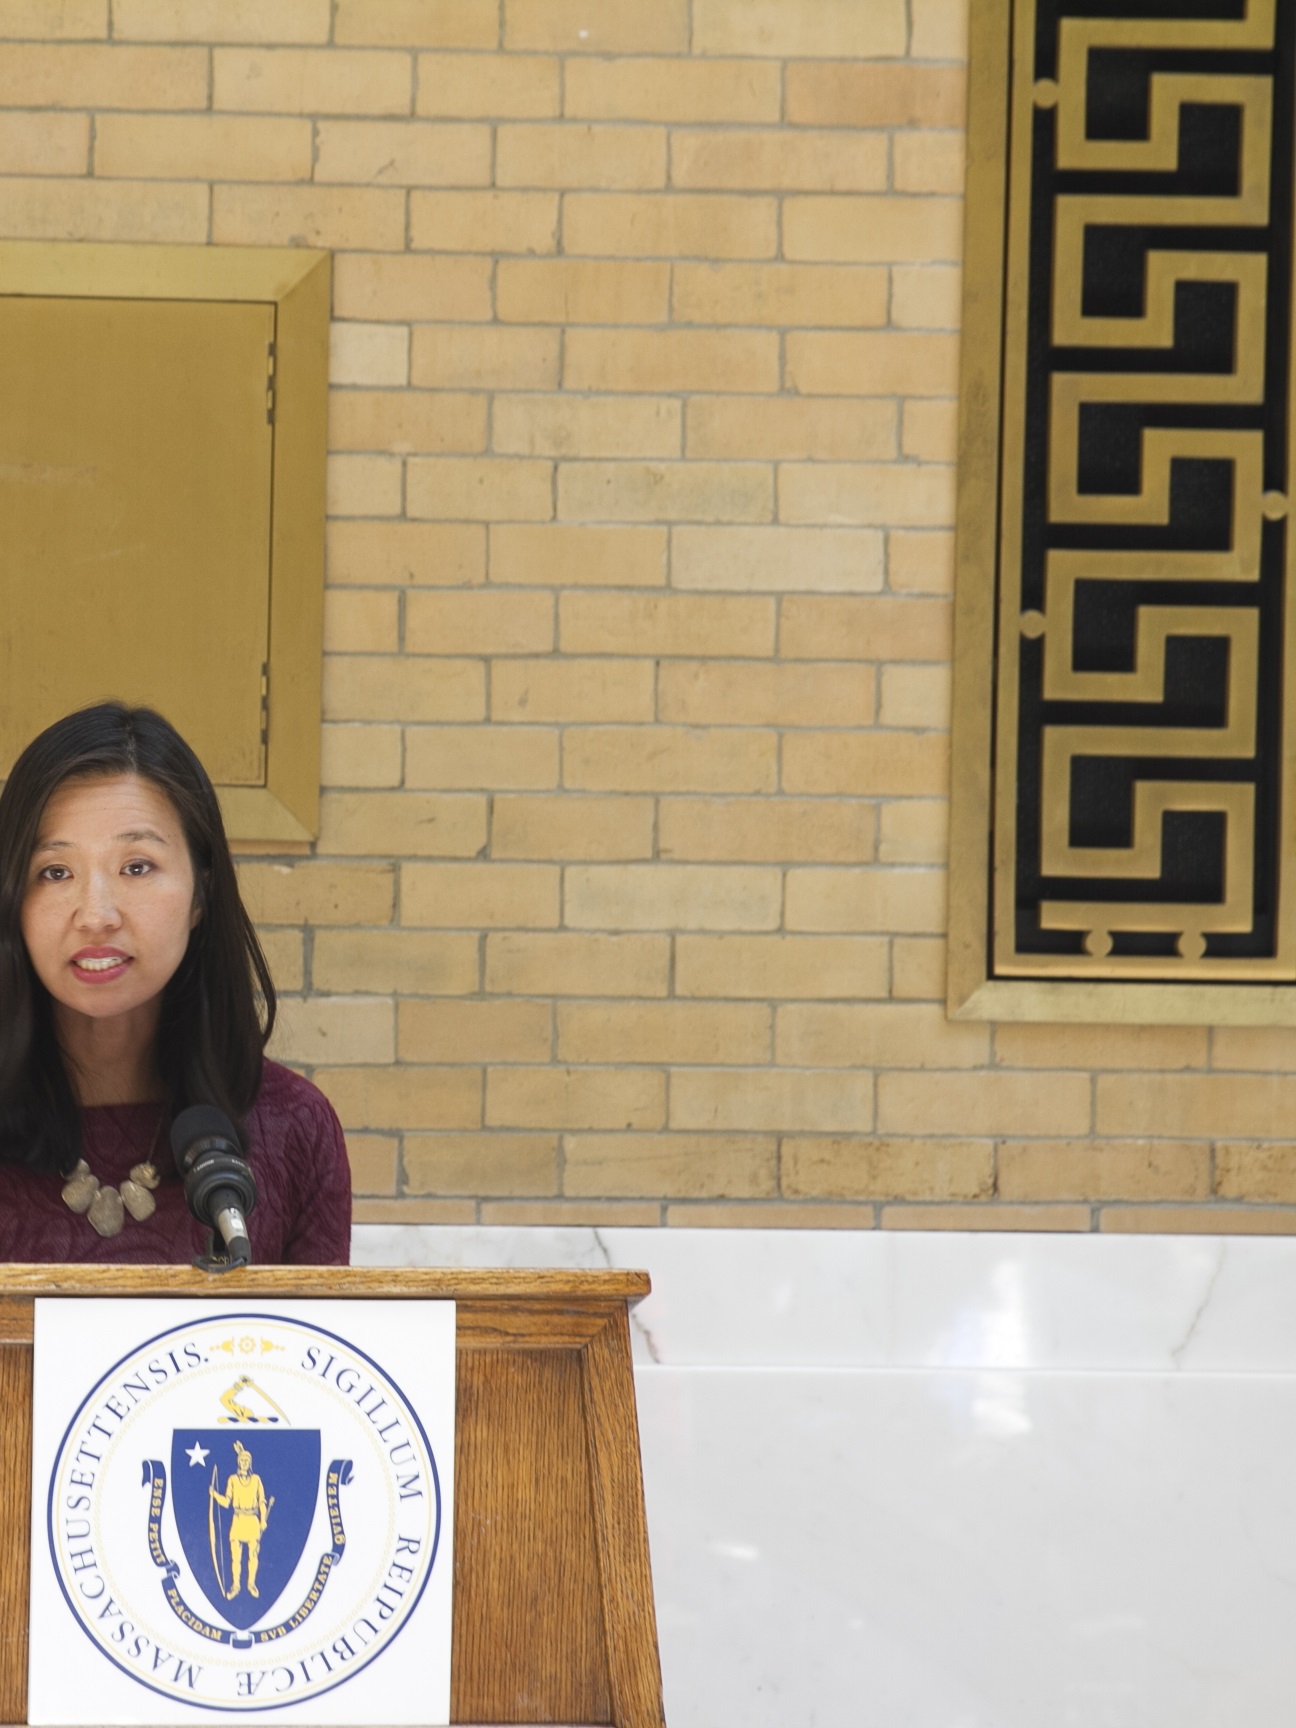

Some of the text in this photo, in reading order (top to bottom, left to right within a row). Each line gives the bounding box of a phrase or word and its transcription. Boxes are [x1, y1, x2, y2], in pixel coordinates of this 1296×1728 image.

[66, 1342, 423, 1697] SIGILLUM REIPUBLICÆ MASSACHUSETTENSIS.
[151, 1477, 164, 1518] ENSE
[149, 1522, 166, 1565] PETIT
[167, 1588, 222, 1641] PLACIDAM
[289, 1554, 333, 1630] LIBERTATE
